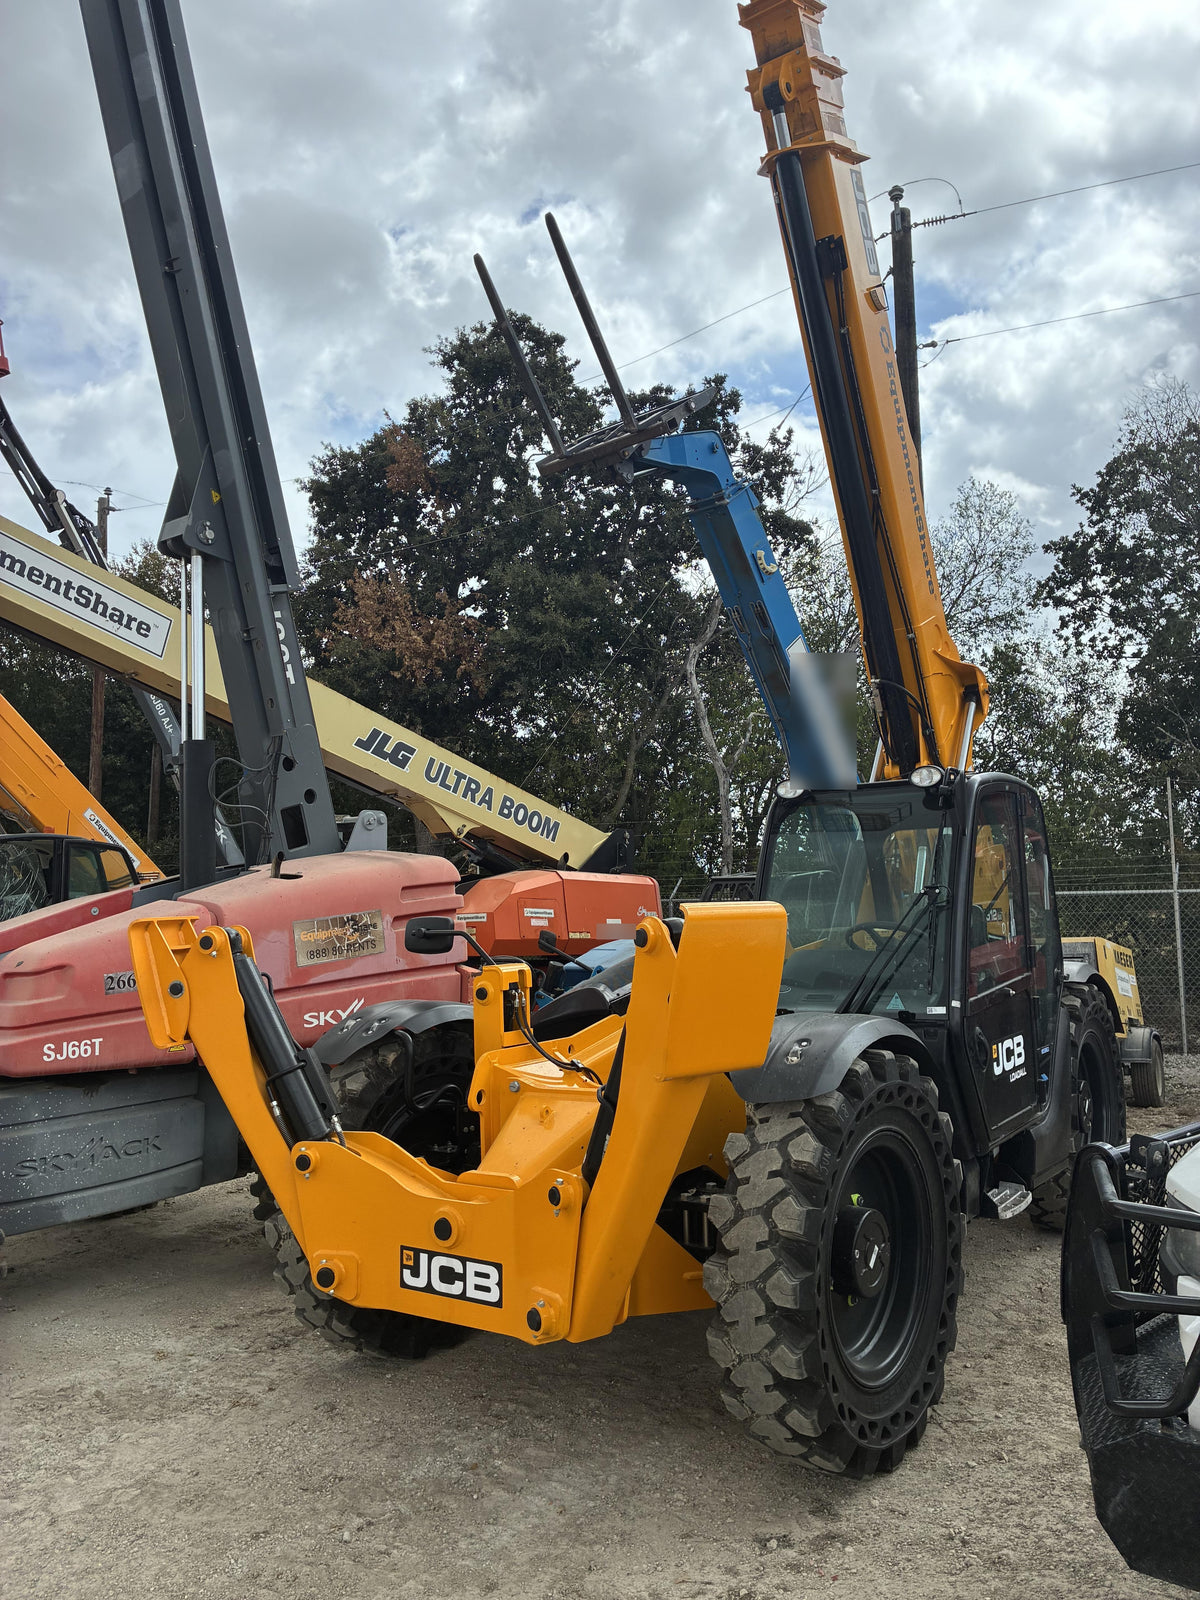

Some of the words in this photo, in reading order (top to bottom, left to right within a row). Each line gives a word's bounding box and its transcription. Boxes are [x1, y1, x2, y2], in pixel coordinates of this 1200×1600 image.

[850, 169, 880, 276] JCB
[886, 361, 935, 596] EquipmentShare
[354, 727, 417, 770] JLG
[424, 756, 495, 812] ULTRA
[498, 794, 561, 843] BOOM
[306, 947, 330, 961] (888)
[105, 973, 137, 991] 266
[42, 1038, 104, 1062] SJ66T
[993, 1034, 1026, 1076] JCB
[402, 1252, 501, 1304] JCB
